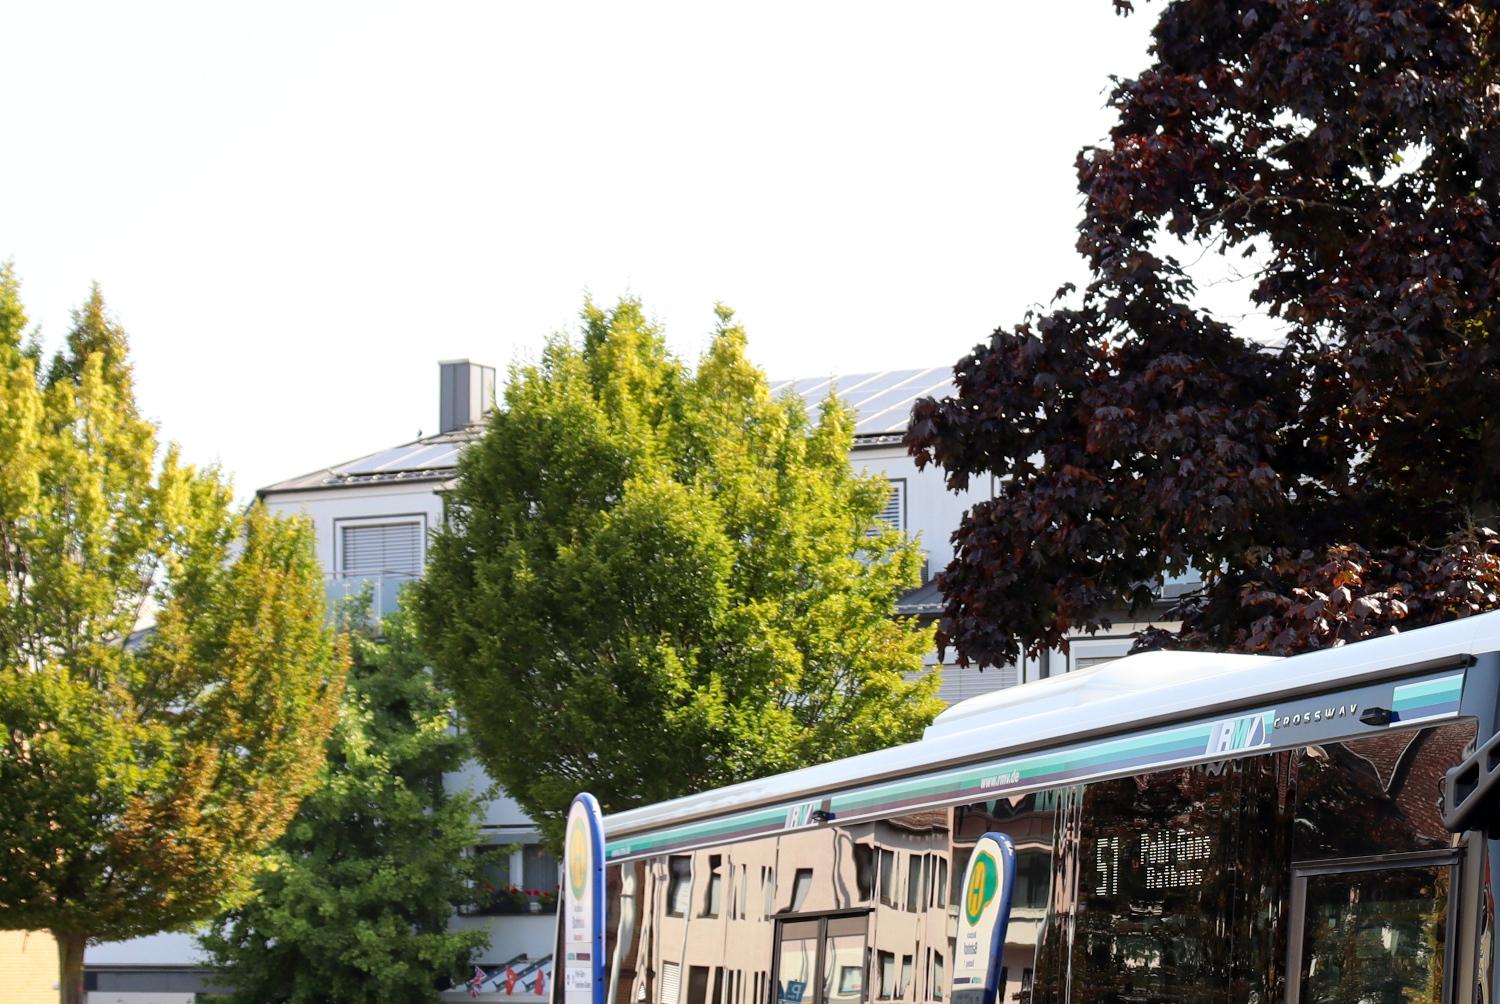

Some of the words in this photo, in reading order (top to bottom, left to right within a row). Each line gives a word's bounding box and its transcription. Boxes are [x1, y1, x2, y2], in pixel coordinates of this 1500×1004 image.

[1274, 703, 1358, 729] CROSSWAY
[1217, 716, 1261, 752] RMV
[981, 769, 1020, 789] www.rmv.de
[1140, 829, 1210, 865] Pohl-Göns
[1096, 837, 1119, 895] 51
[1146, 865, 1203, 889] Rathaus
